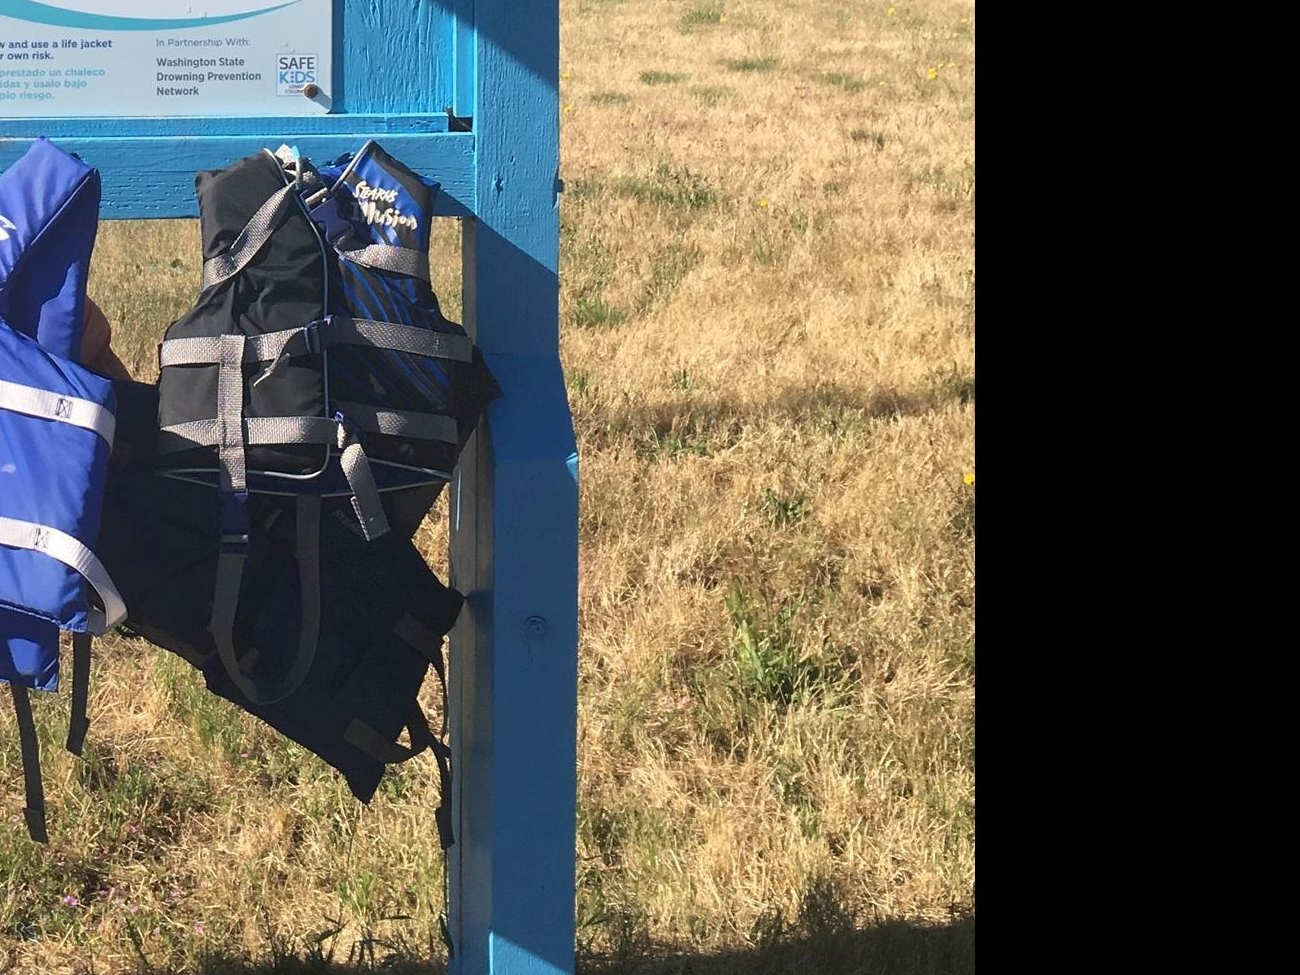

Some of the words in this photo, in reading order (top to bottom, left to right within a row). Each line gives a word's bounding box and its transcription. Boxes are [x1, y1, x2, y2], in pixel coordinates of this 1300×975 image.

[9, 40, 28, 48] and
[62, 40, 77, 48] life
[81, 40, 112, 49] jacket
[168, 39, 222, 47] Partnership
[32, 51, 53, 60] risk.
[157, 58, 216, 68] Washington
[219, 57, 244, 66] State
[280, 57, 314, 70] SAFE
[157, 72, 204, 82] Drowning
[208, 72, 261, 80] Prevention
[157, 87, 199, 95] Network
